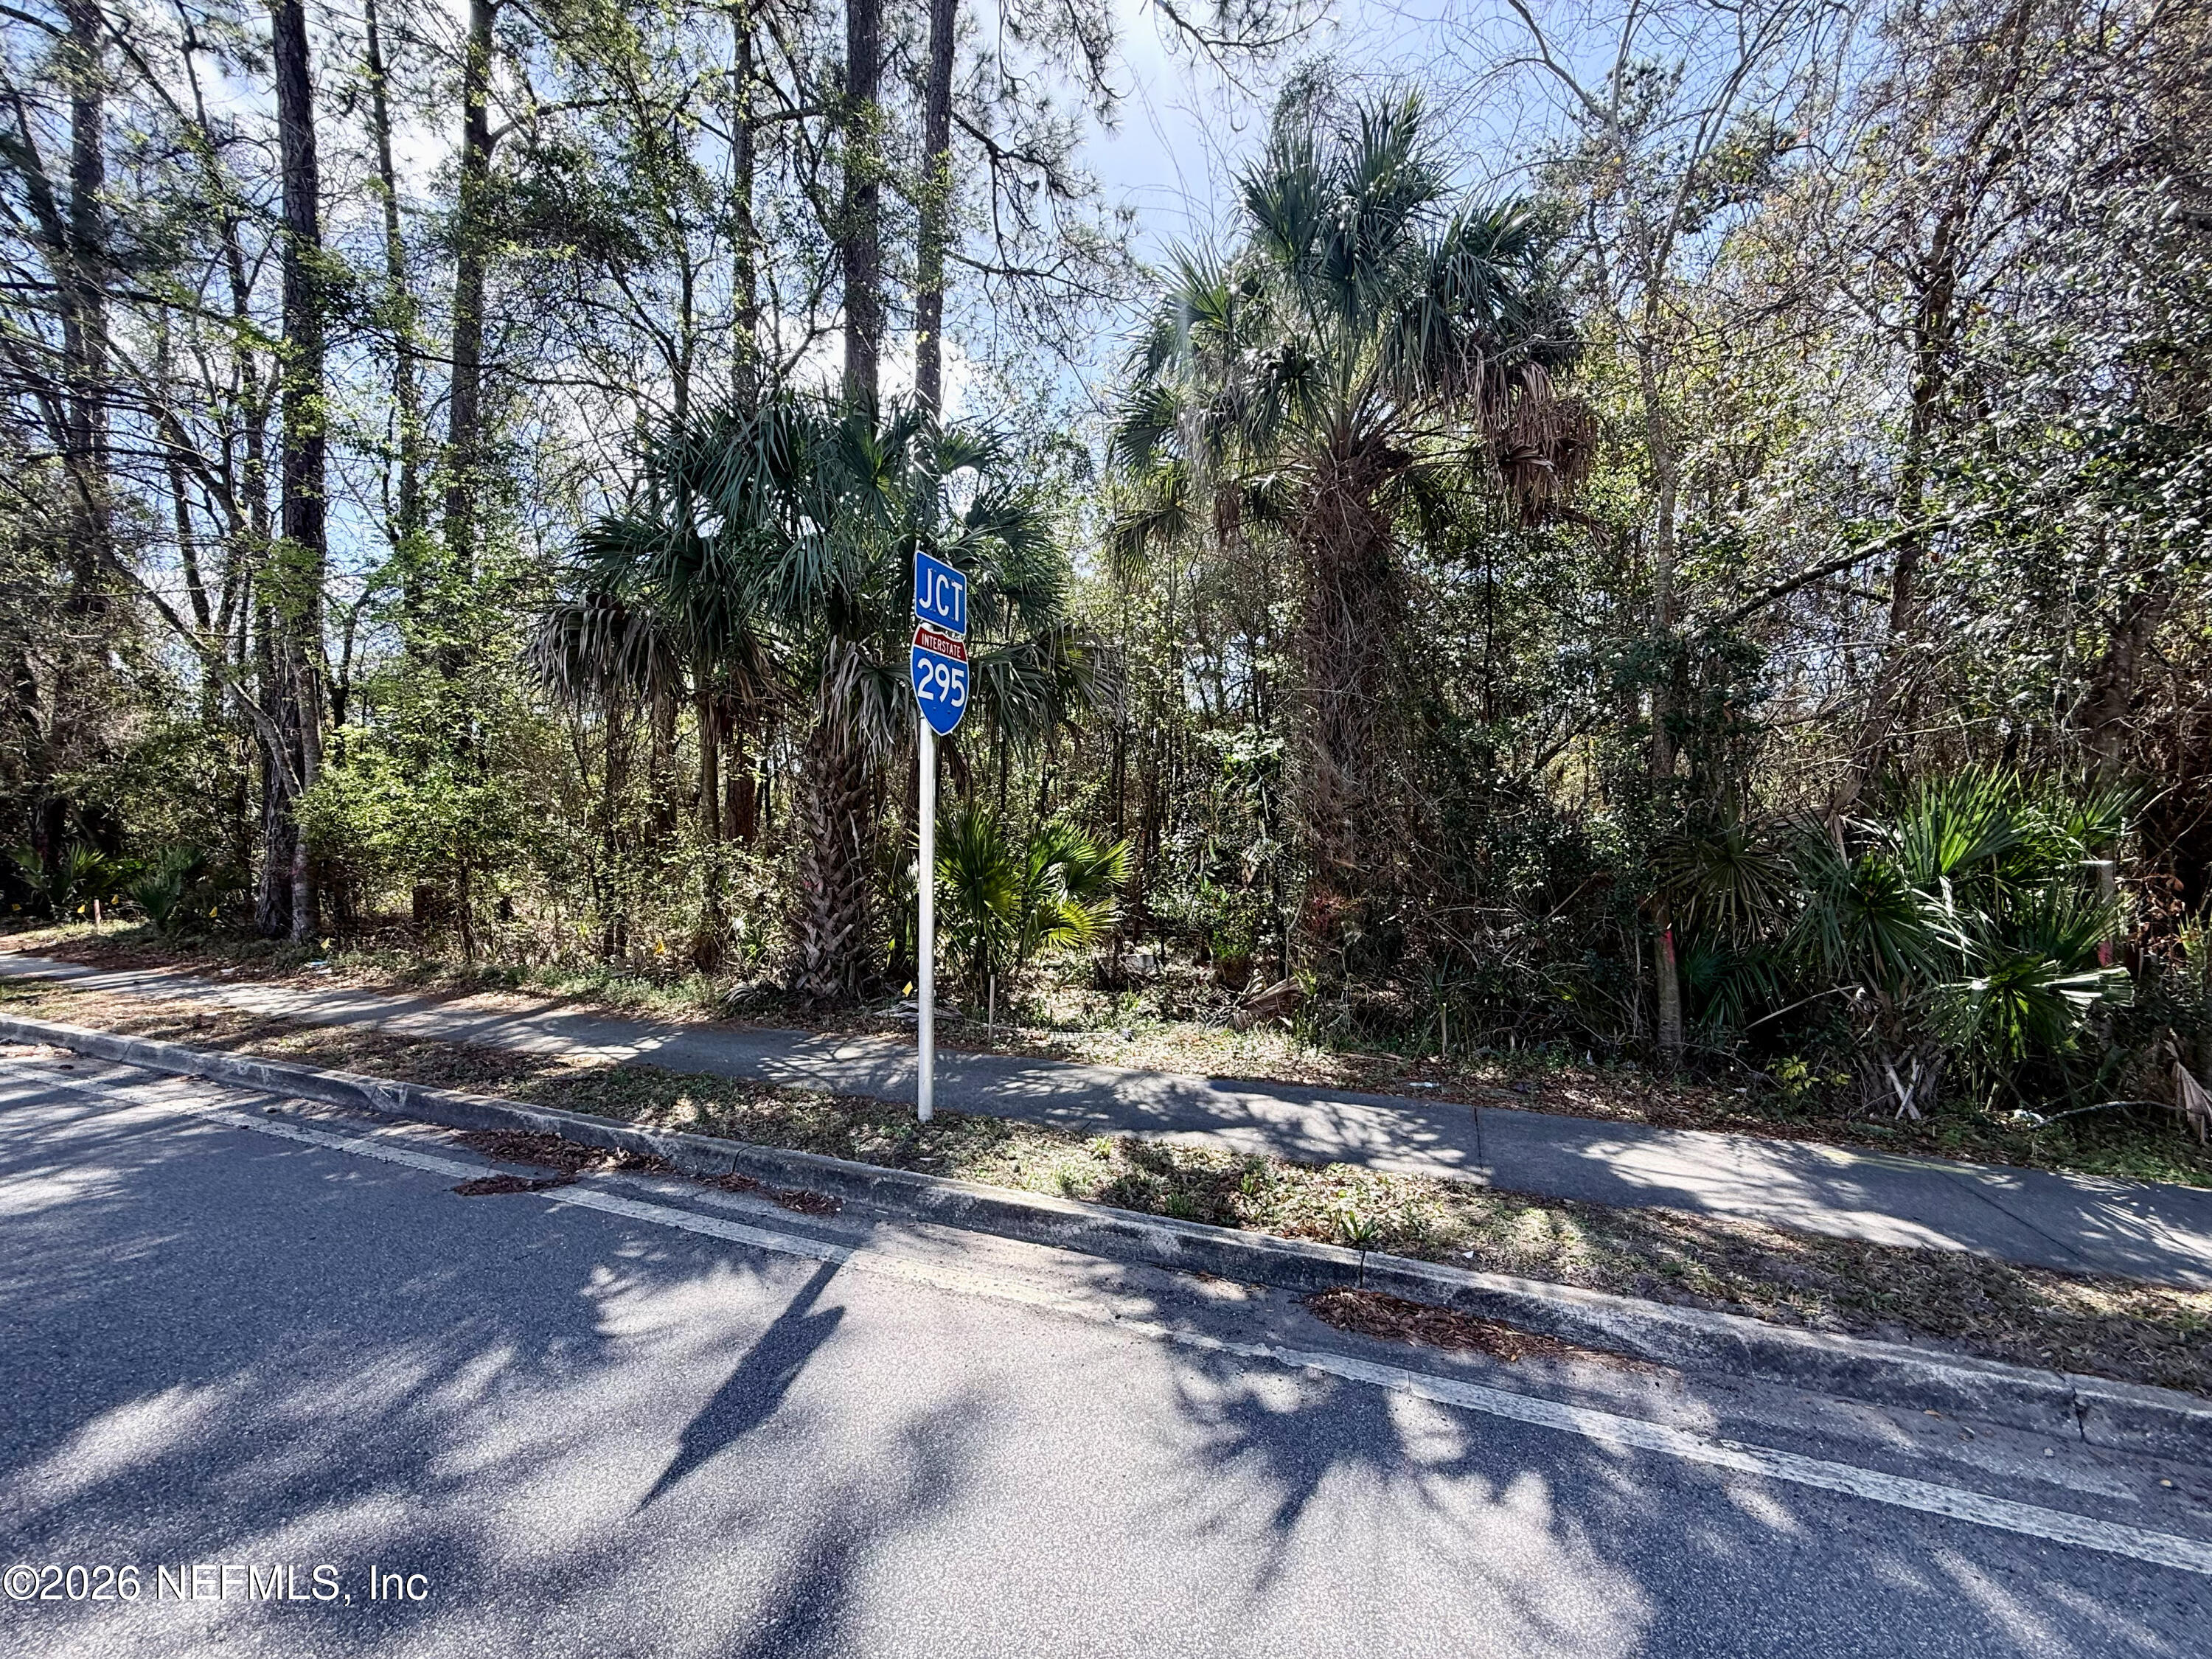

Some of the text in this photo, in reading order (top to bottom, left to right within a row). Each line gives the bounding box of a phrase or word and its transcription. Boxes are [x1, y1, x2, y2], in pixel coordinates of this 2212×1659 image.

[919, 568, 962, 622] JCT
[922, 633, 961, 658] INTERSTATE
[918, 659, 966, 707] 295
